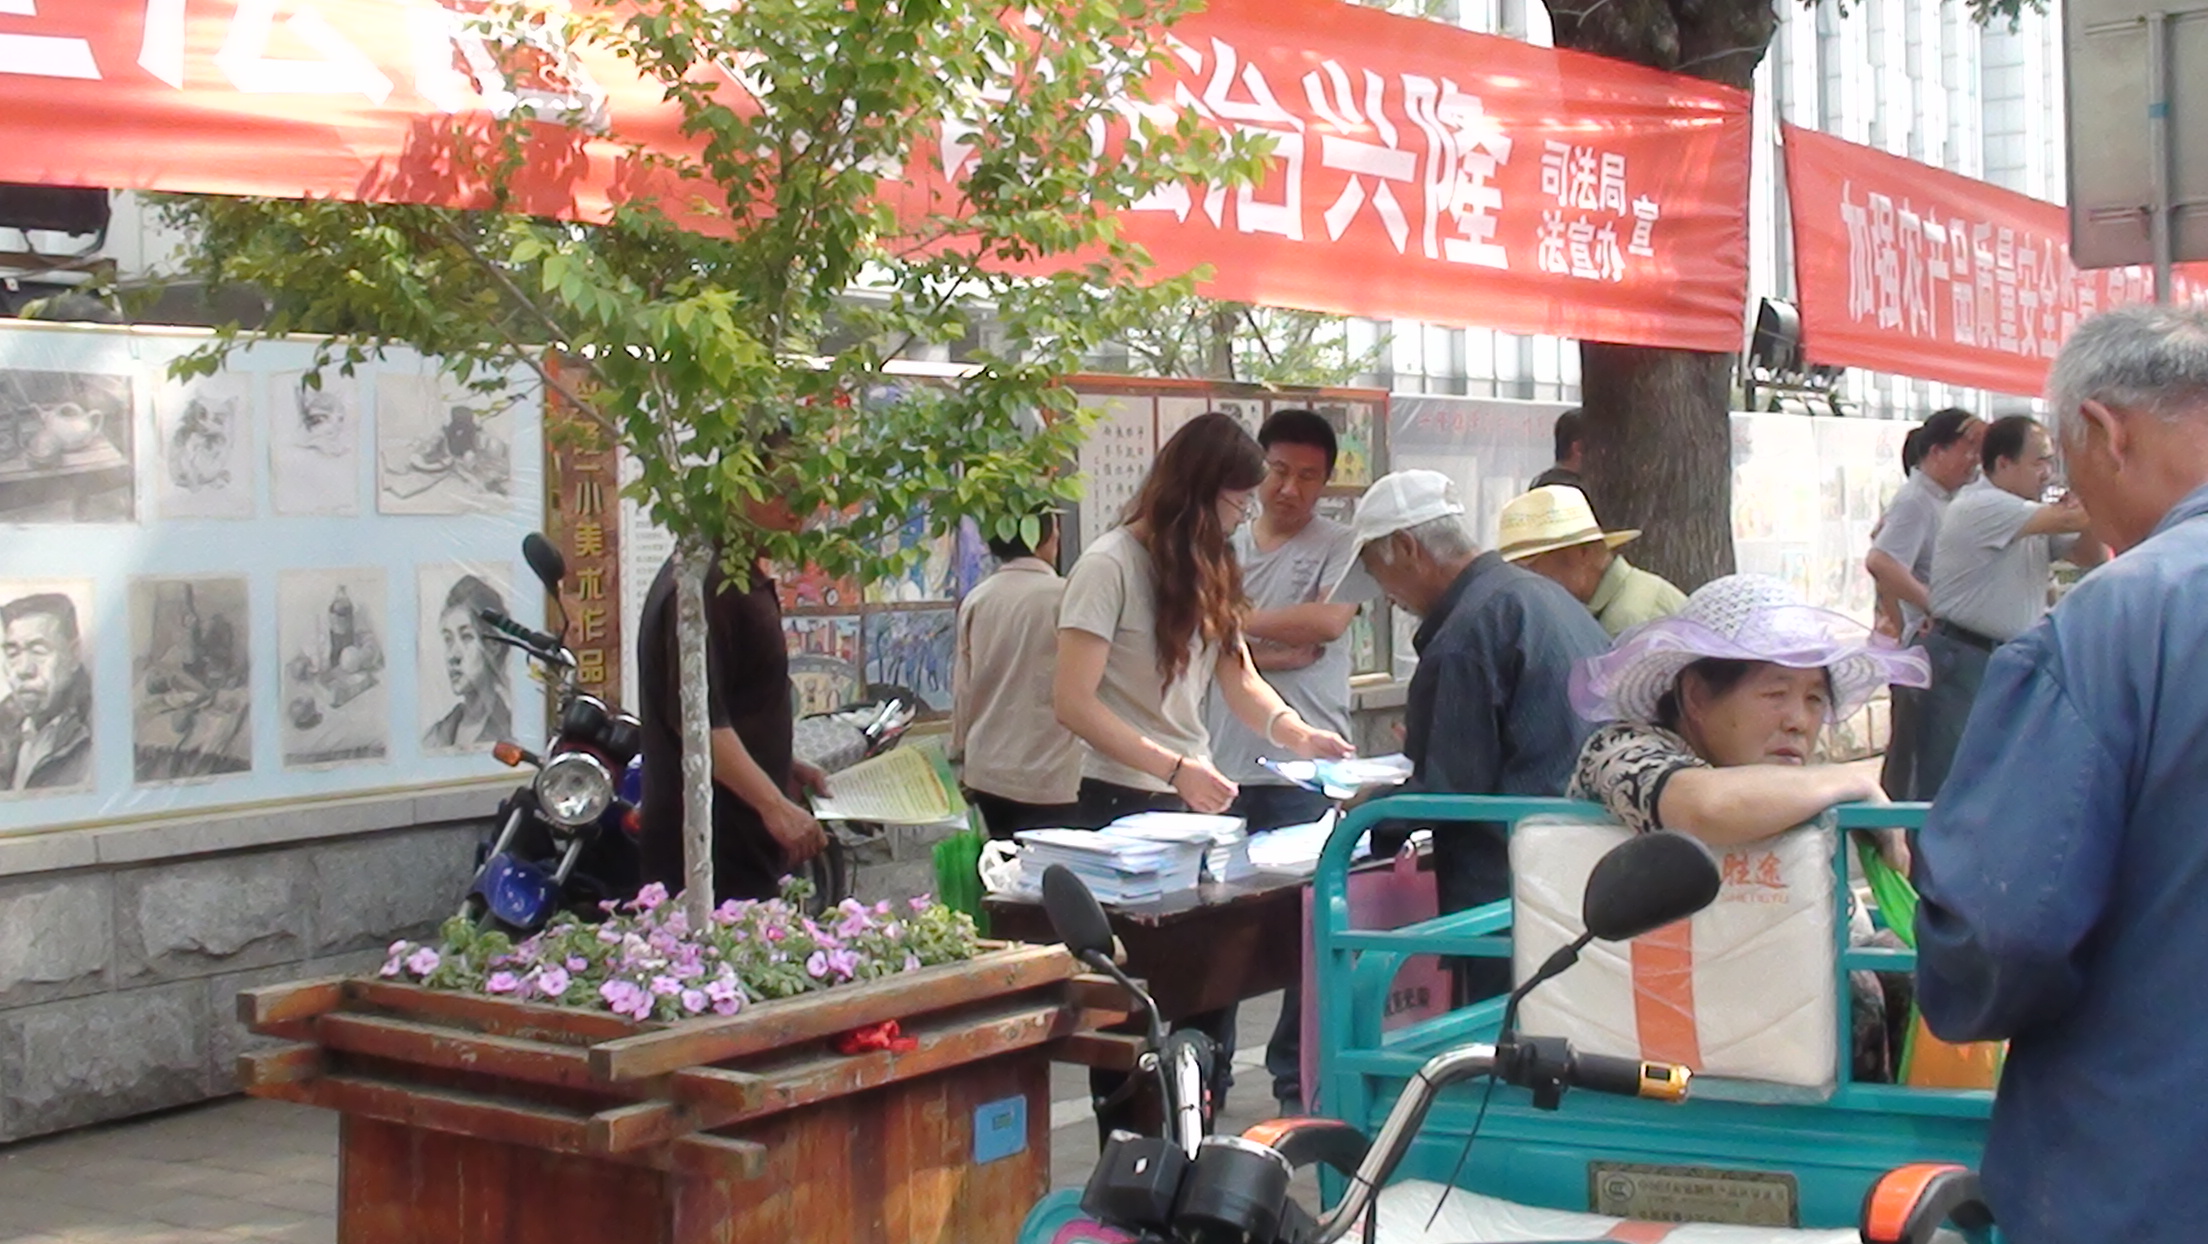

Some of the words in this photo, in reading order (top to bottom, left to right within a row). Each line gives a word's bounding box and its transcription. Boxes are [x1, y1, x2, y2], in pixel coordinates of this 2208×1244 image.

[1541, 139, 1627, 218] 司法局
[1536, 209, 1627, 283] 法宣办
[1628, 194, 1660, 257] 宣
